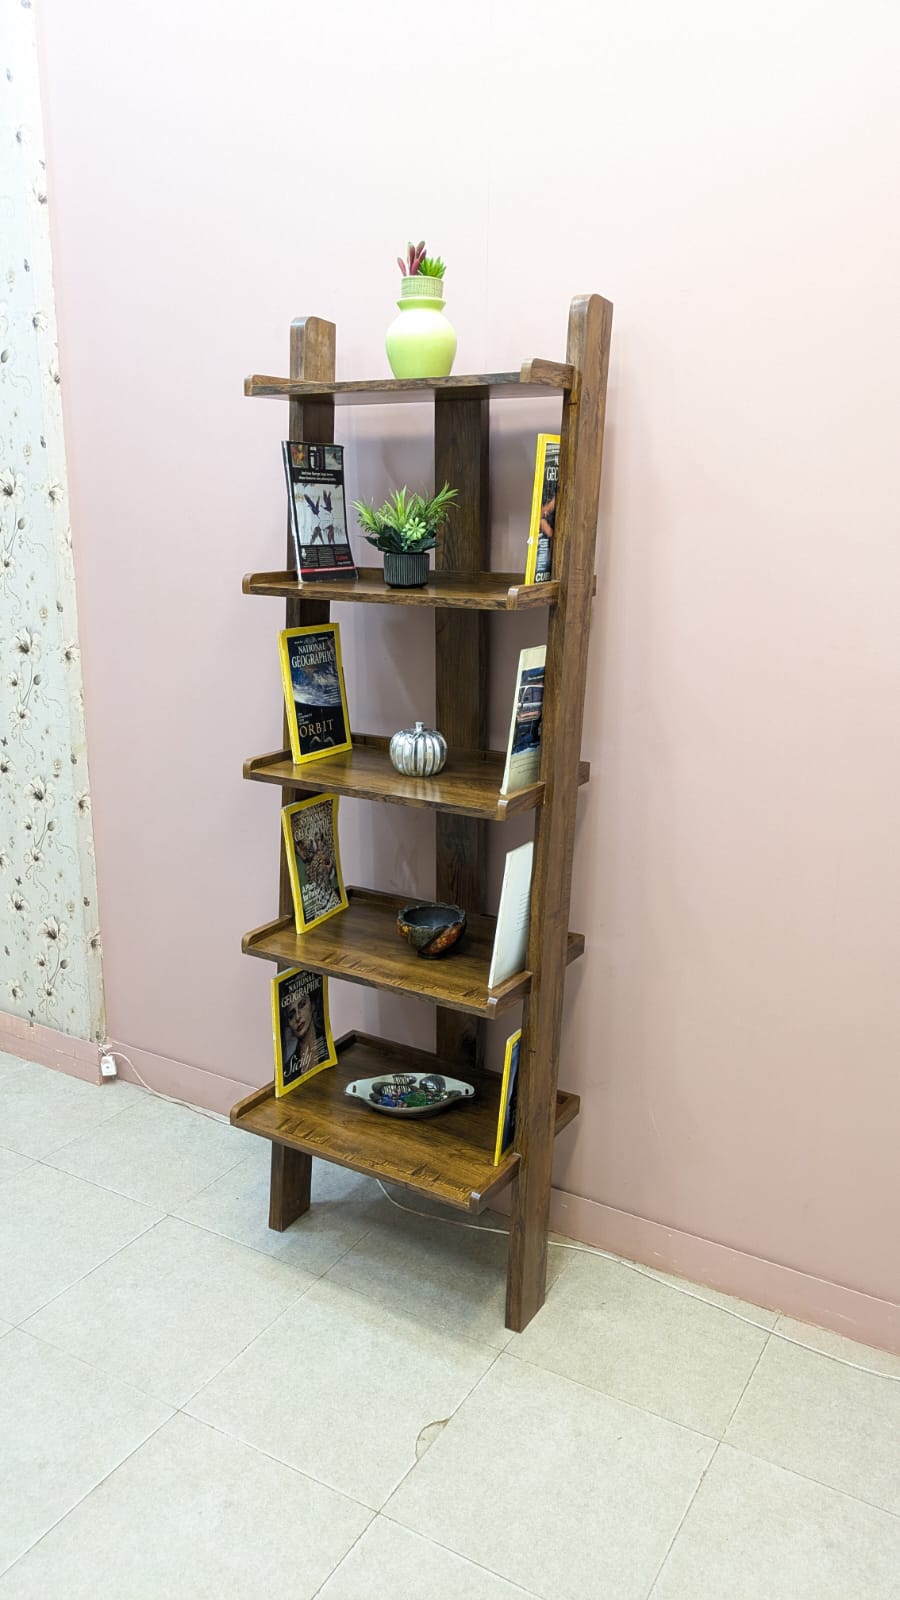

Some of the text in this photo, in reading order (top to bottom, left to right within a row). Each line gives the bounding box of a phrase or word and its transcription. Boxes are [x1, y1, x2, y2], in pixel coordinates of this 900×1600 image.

[298, 641, 326, 654] NATIONAL
[291, 650, 335, 669] GEOGRAPHIC
[299, 719, 334, 738] ORBIT
[288, 973, 315, 992] NATIONAL
[281, 977, 321, 1008] GEOGRAPHIC
[283, 1047, 313, 1078] Sicily
